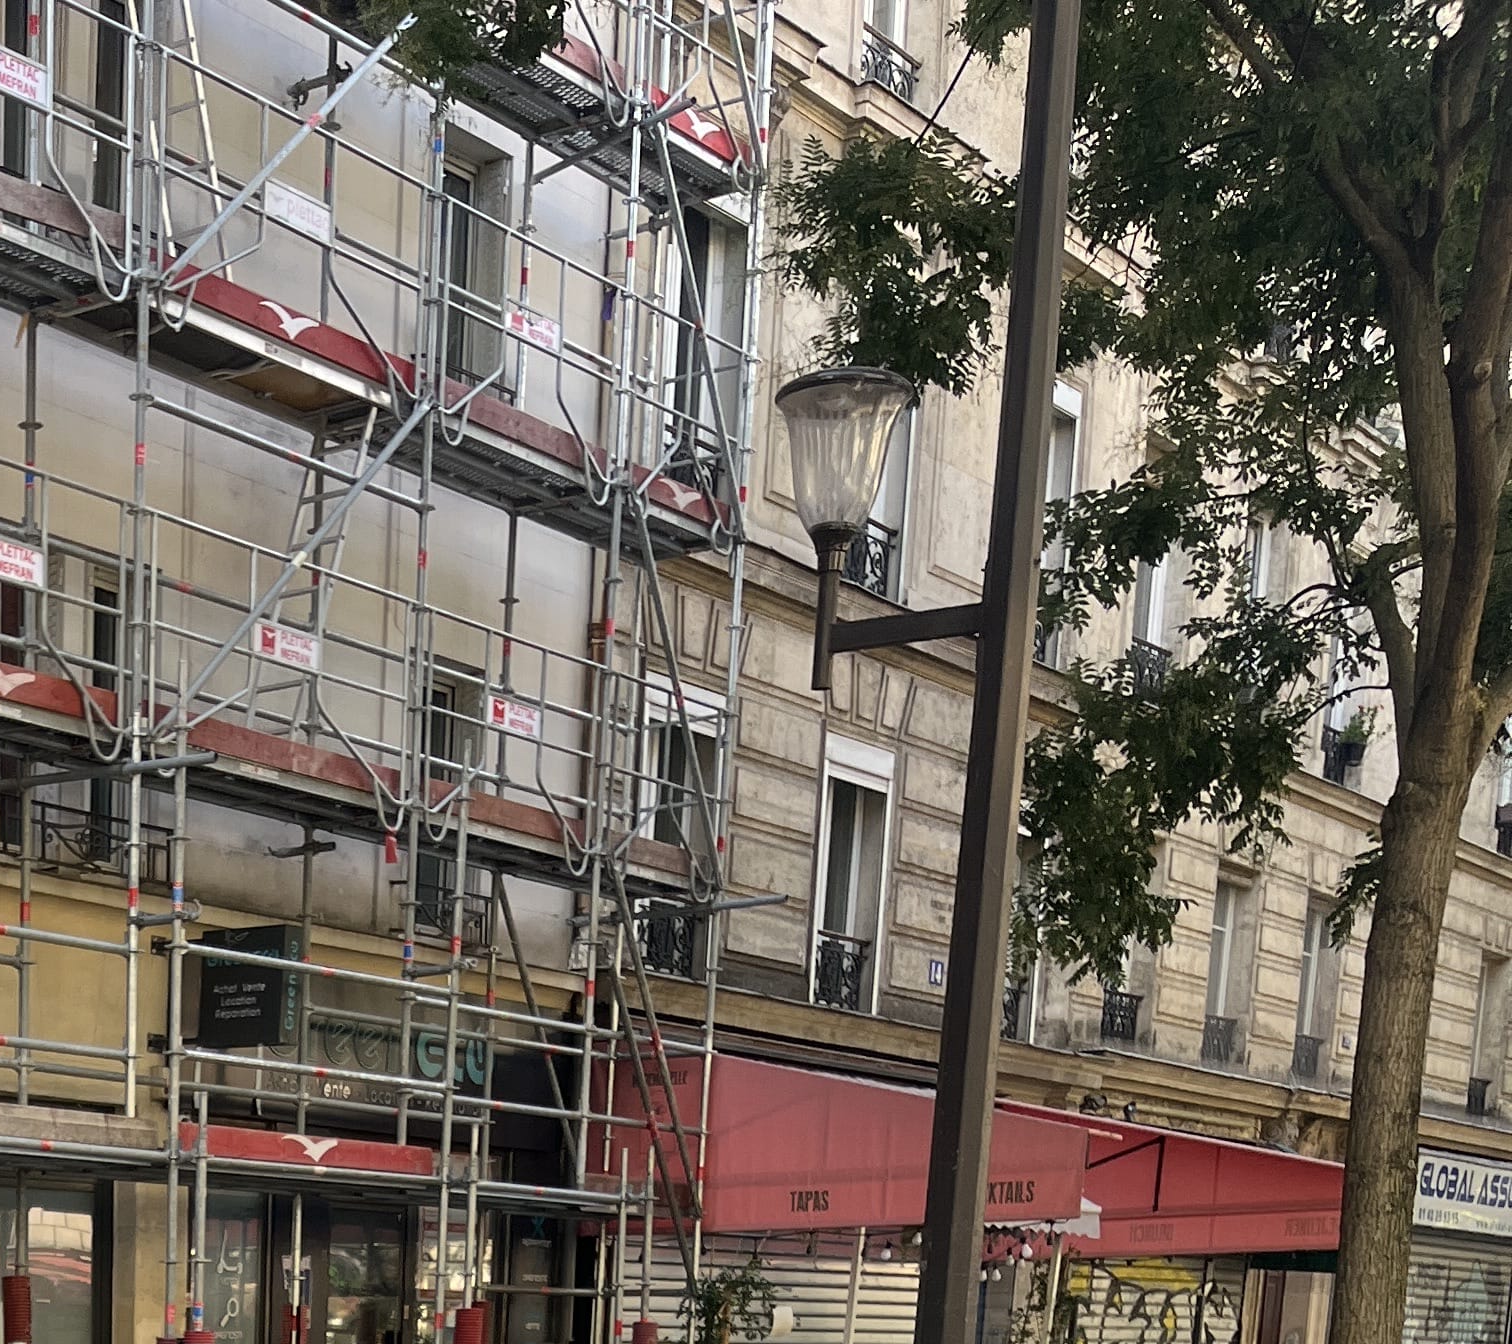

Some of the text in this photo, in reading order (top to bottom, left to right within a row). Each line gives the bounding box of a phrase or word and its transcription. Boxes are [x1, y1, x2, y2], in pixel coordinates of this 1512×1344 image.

[280, 630, 312, 651] PLETTAC
[930, 961, 942, 985] 14
[1419, 1162, 1475, 1204] GLOBAL
[790, 1190, 829, 1213] TAPAS
